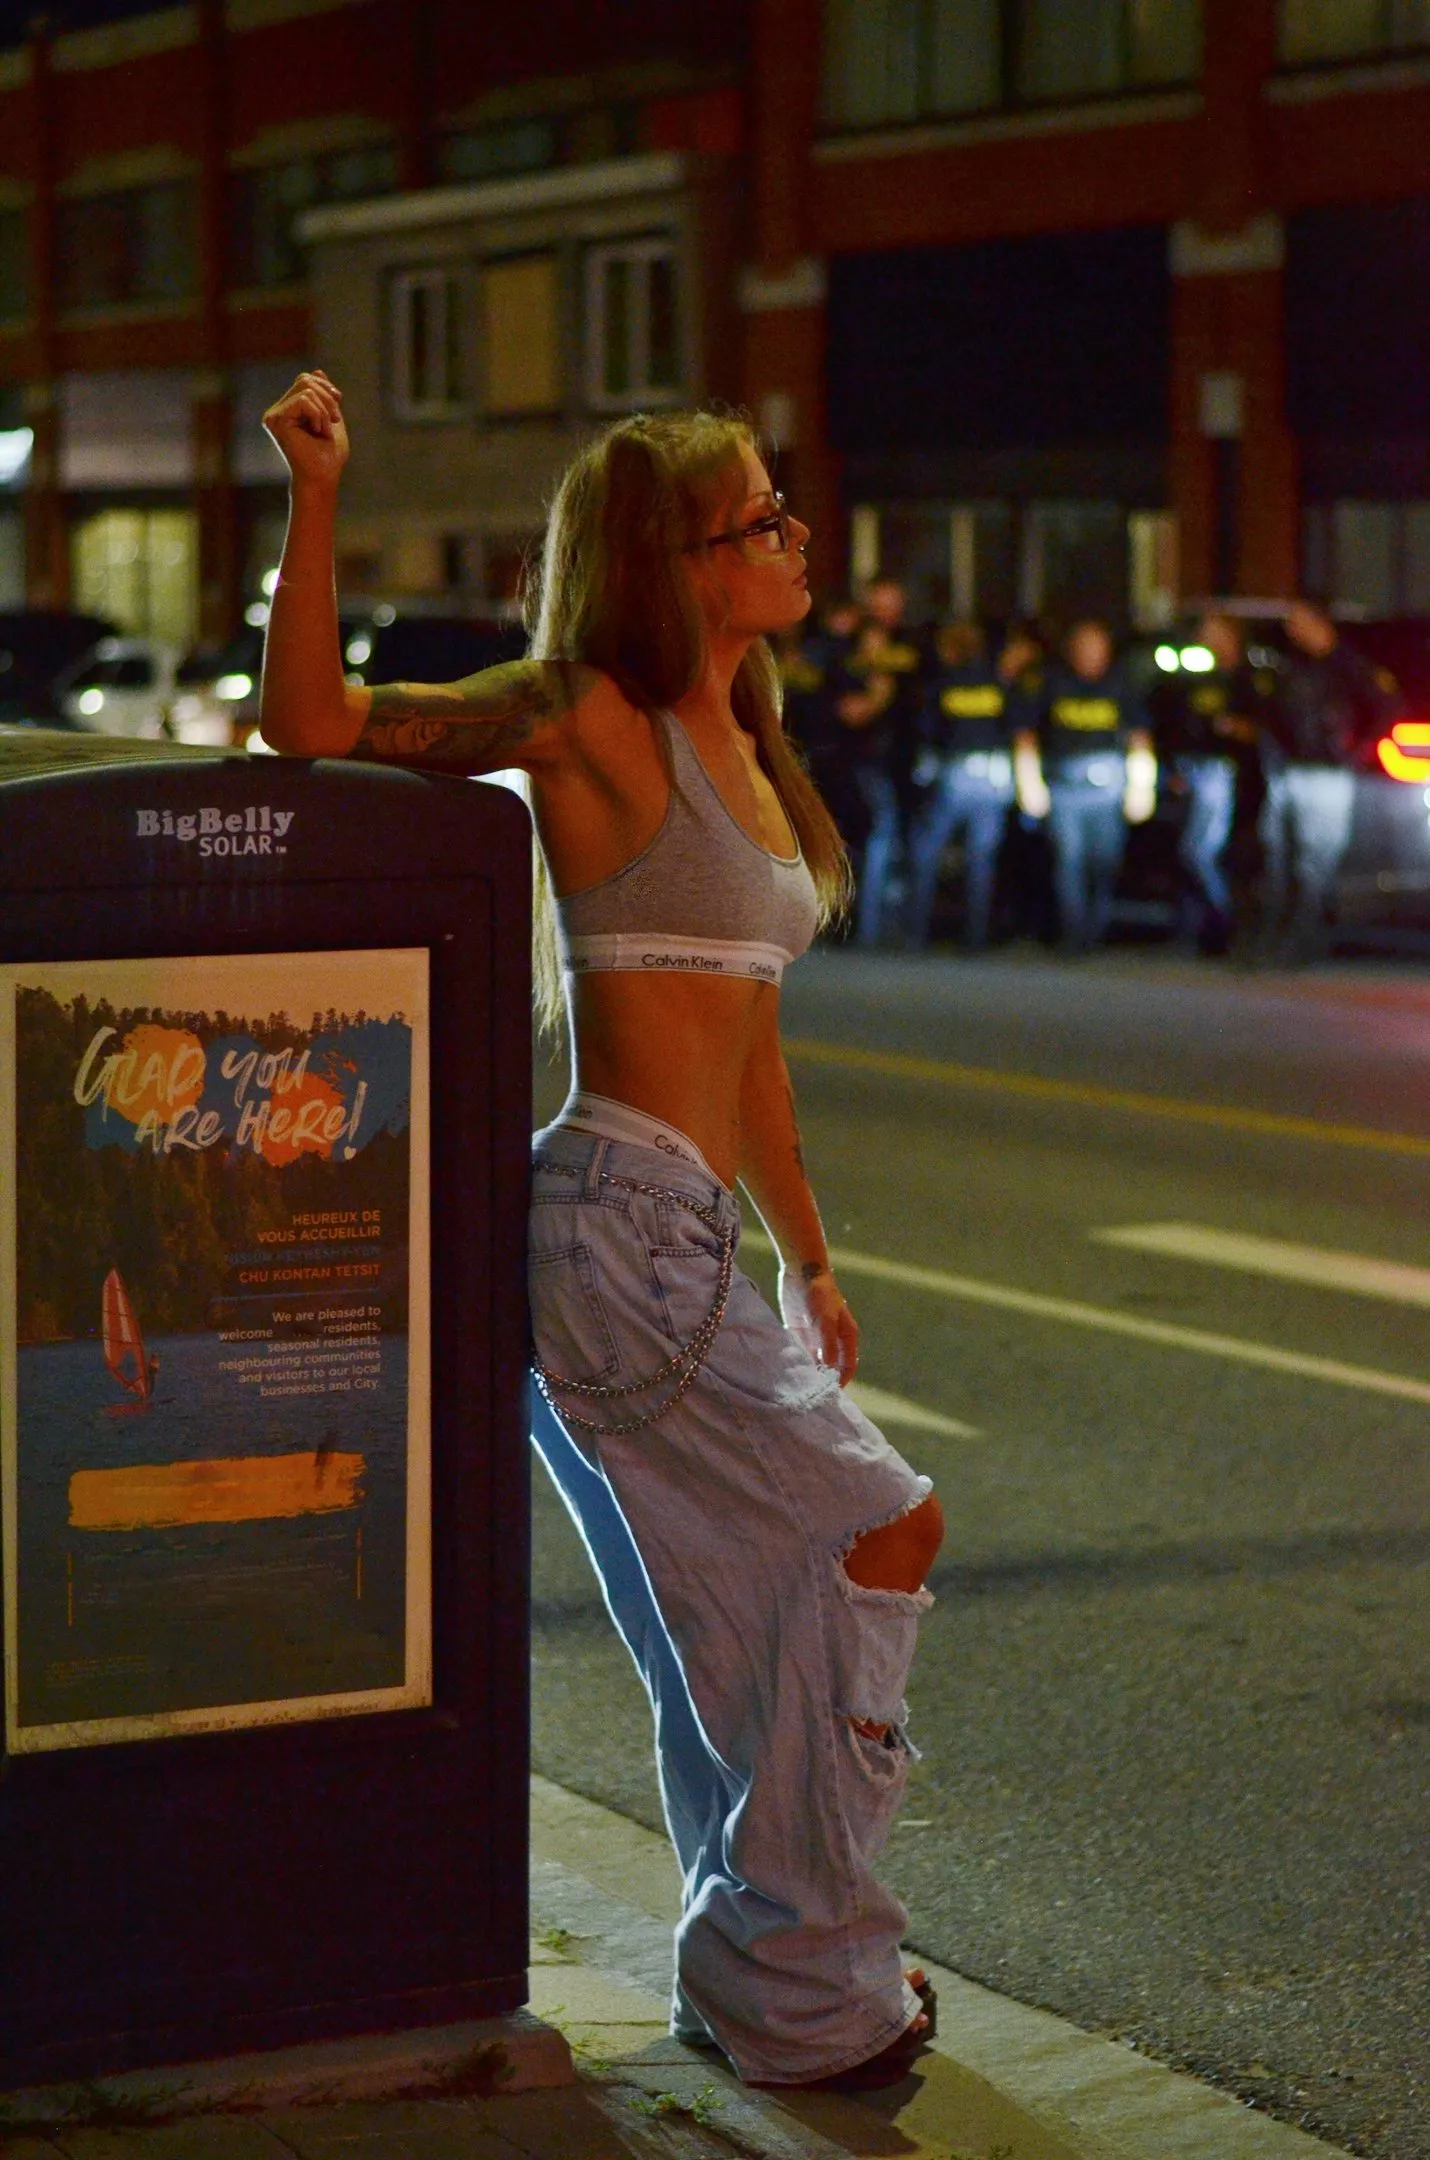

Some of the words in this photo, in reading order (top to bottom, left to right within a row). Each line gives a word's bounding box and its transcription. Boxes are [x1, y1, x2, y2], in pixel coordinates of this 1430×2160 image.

[136, 805, 295, 843] BigBelly
[199, 834, 273, 857] SOLAR
[641, 953, 689, 967] Calvin
[691, 955, 724, 970] Klein
[292, 1211, 358, 1226] HEUREUX
[362, 1209, 381, 1223] DE
[256, 1229, 296, 1243] VOUS
[300, 1225, 381, 1242] ACCUEILLIR
[239, 1270, 269, 1285] CHU
[273, 1266, 332, 1282] KONTAN
[272, 1311, 292, 1323] We
[295, 1311, 315, 1322] are
[318, 1306, 365, 1322] pleased
[368, 1305, 381, 1317] to
[218, 1328, 274, 1342] welcome
[266, 1338, 320, 1353] seasonal
[218, 1355, 301, 1372] neighbouring
[304, 1350, 381, 1365] communities
[238, 1372, 262, 1384] and
[266, 1369, 310, 1382] visitors
[312, 1367, 326, 1379] to
[328, 1366, 349, 1377] our
[352, 1362, 381, 1375] local
[260, 1383, 326, 1397] businesses
[328, 1379, 351, 1392] and
